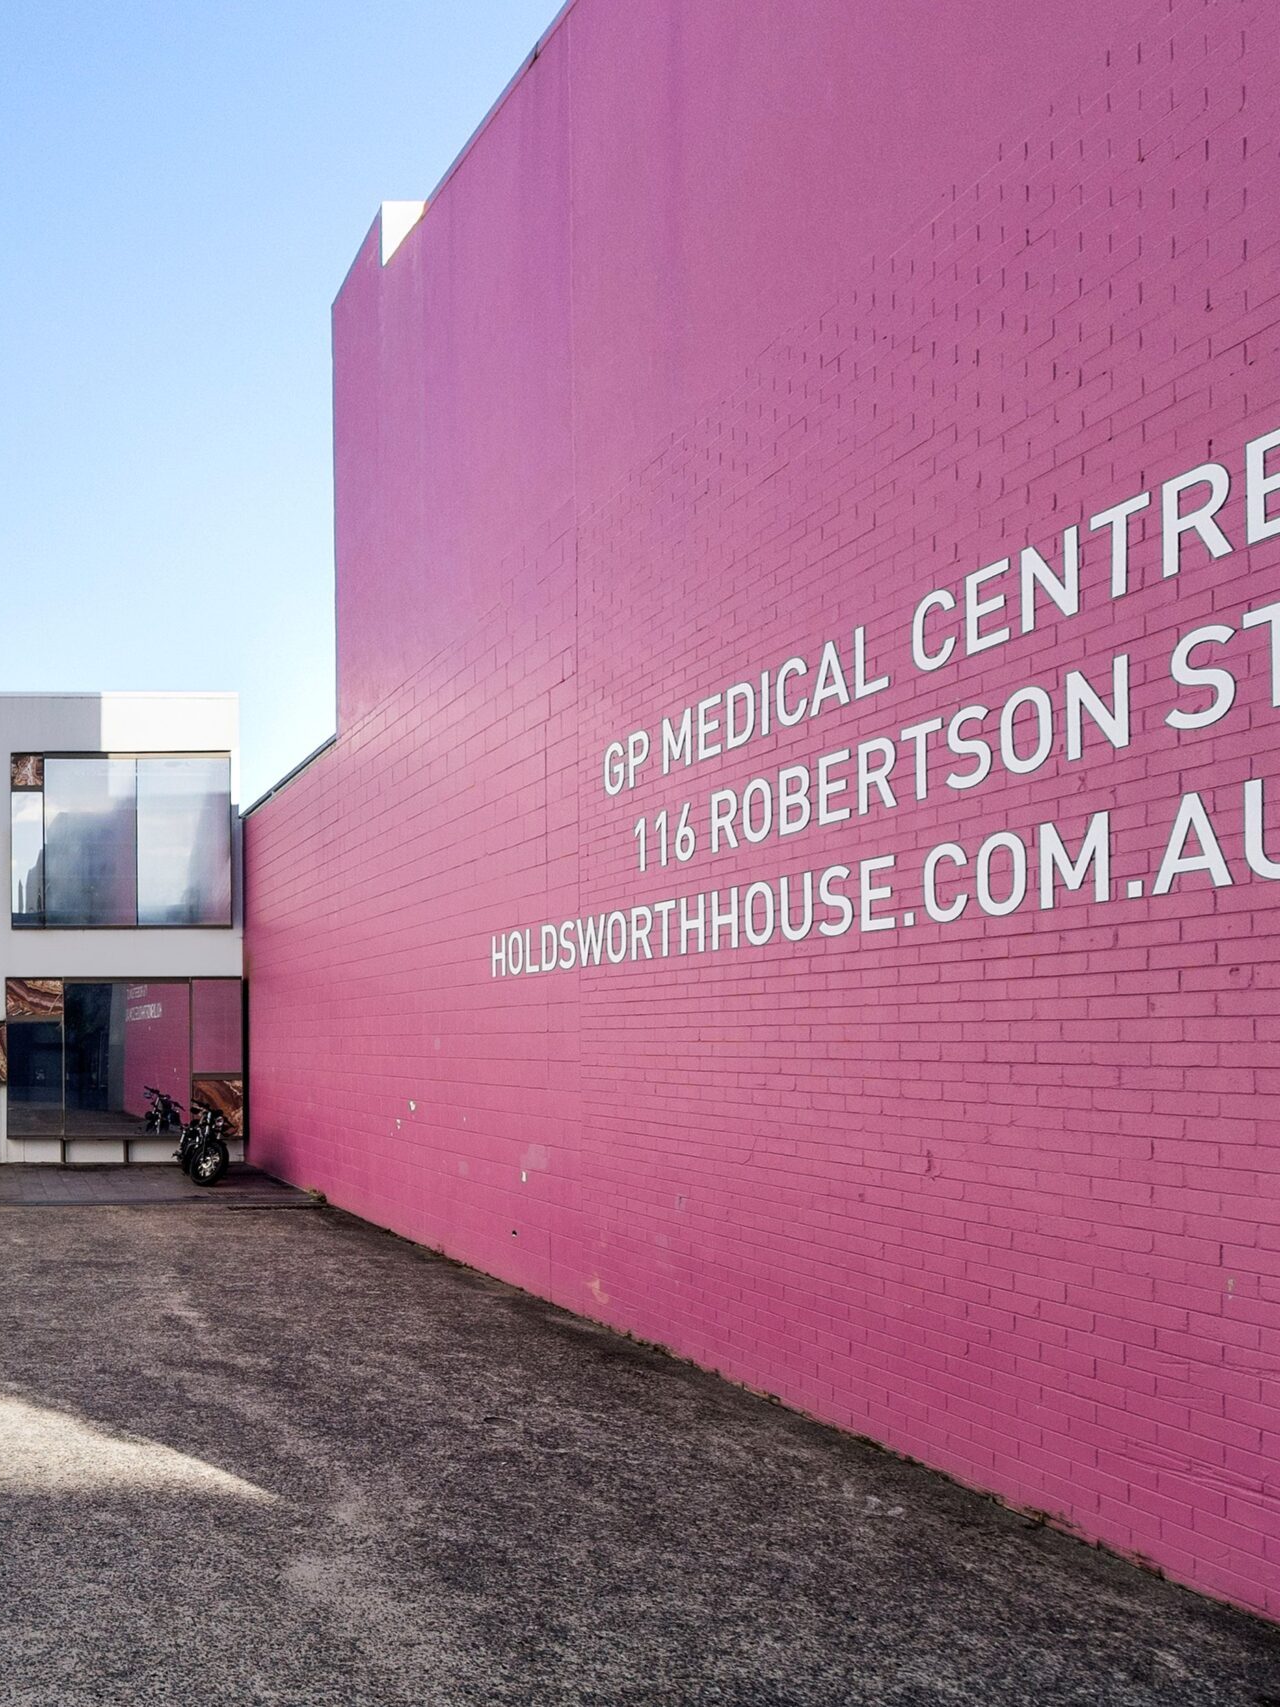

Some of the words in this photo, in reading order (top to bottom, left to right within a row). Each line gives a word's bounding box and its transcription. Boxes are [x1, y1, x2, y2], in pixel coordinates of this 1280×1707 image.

[603, 730, 650, 796] GP
[661, 626, 889, 776] MEDICAL
[912, 428, 1280, 671] CENTRE
[634, 801, 696, 873] 116
[710, 653, 1129, 854] ROBERTSON
